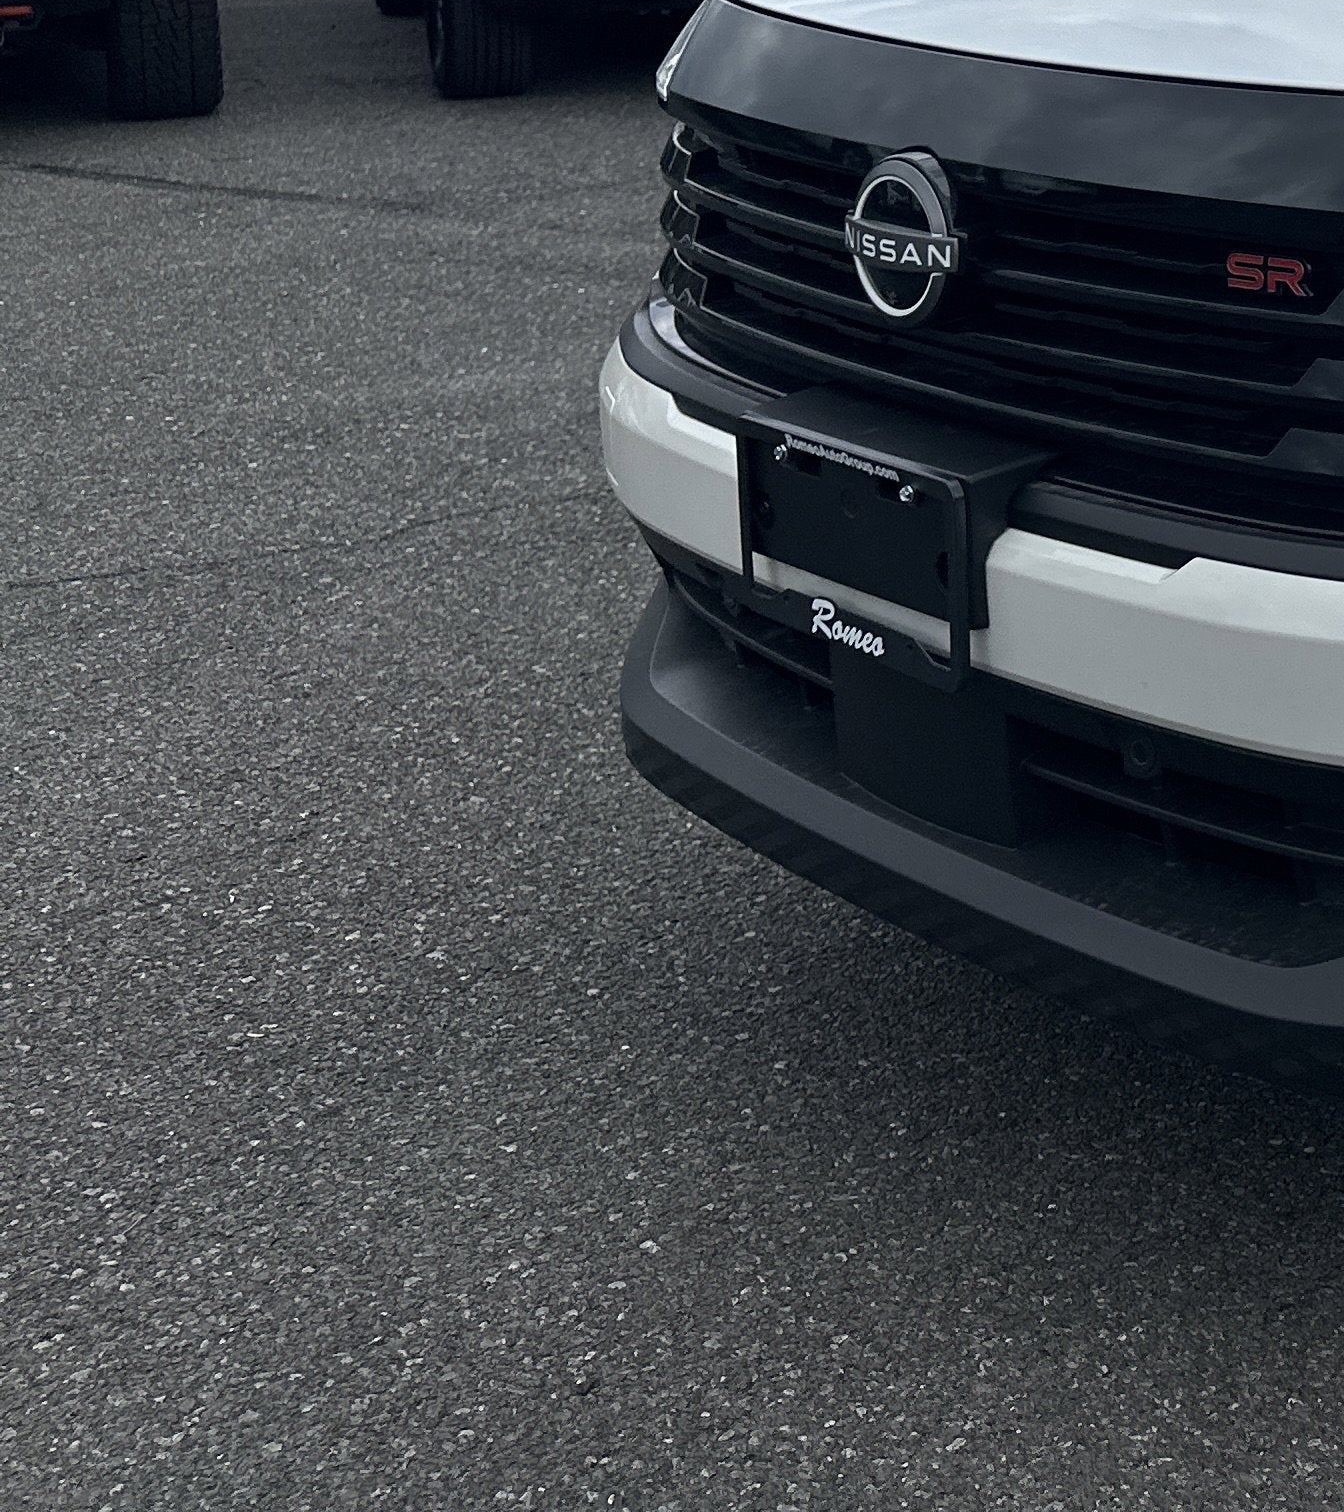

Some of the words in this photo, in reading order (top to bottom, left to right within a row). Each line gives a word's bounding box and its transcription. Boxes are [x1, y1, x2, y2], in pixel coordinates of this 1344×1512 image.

[845, 221, 951, 268] NISSAN
[1226, 252, 1307, 297] SR
[811, 597, 885, 657] Romeo
